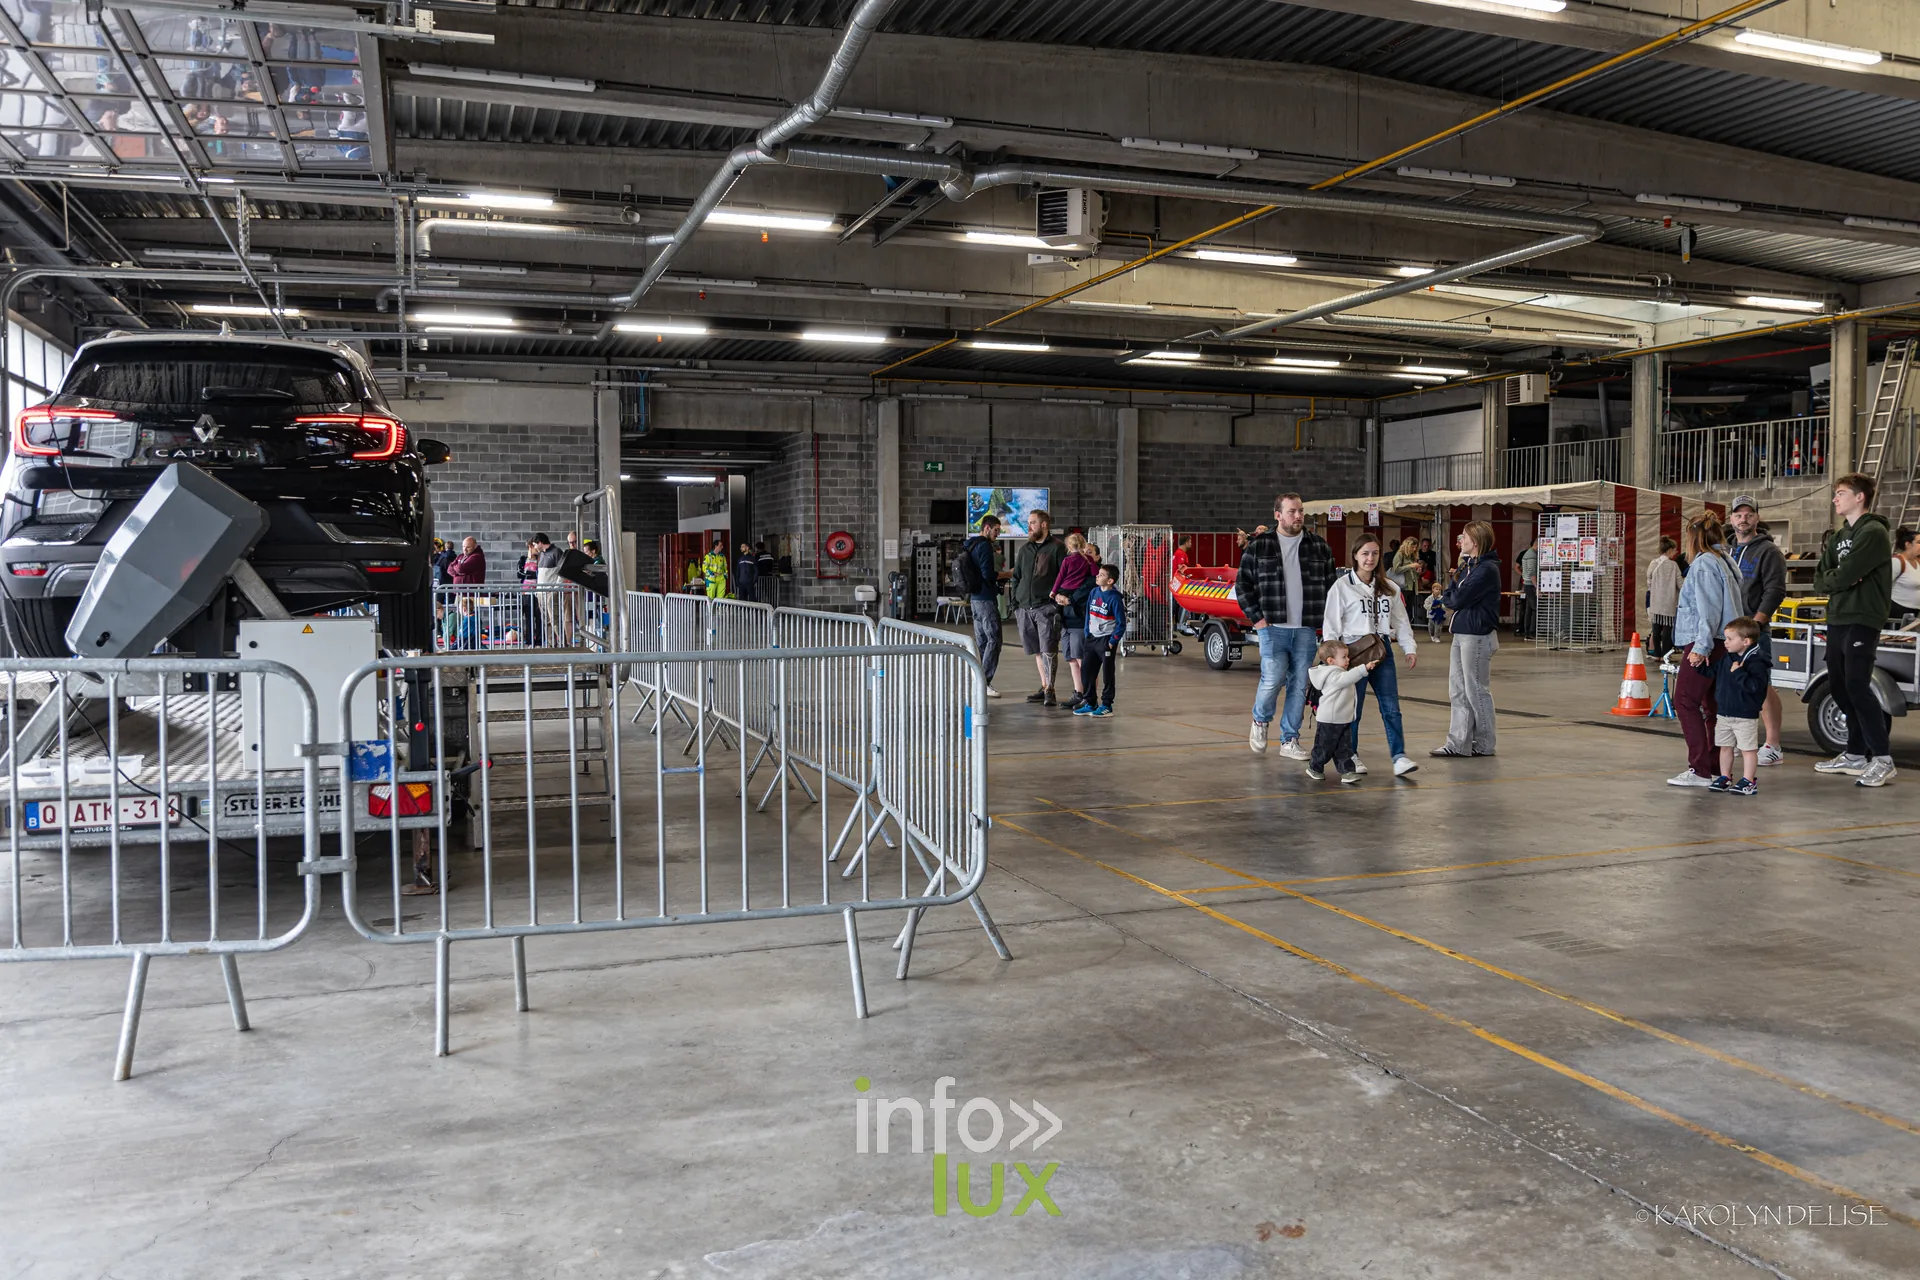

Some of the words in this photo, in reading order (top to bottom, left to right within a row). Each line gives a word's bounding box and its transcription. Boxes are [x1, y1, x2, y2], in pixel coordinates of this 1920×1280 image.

[155, 449, 258, 458] CAPTUR
[1360, 598, 1390, 615] 1903
[28, 817, 37, 827] B
